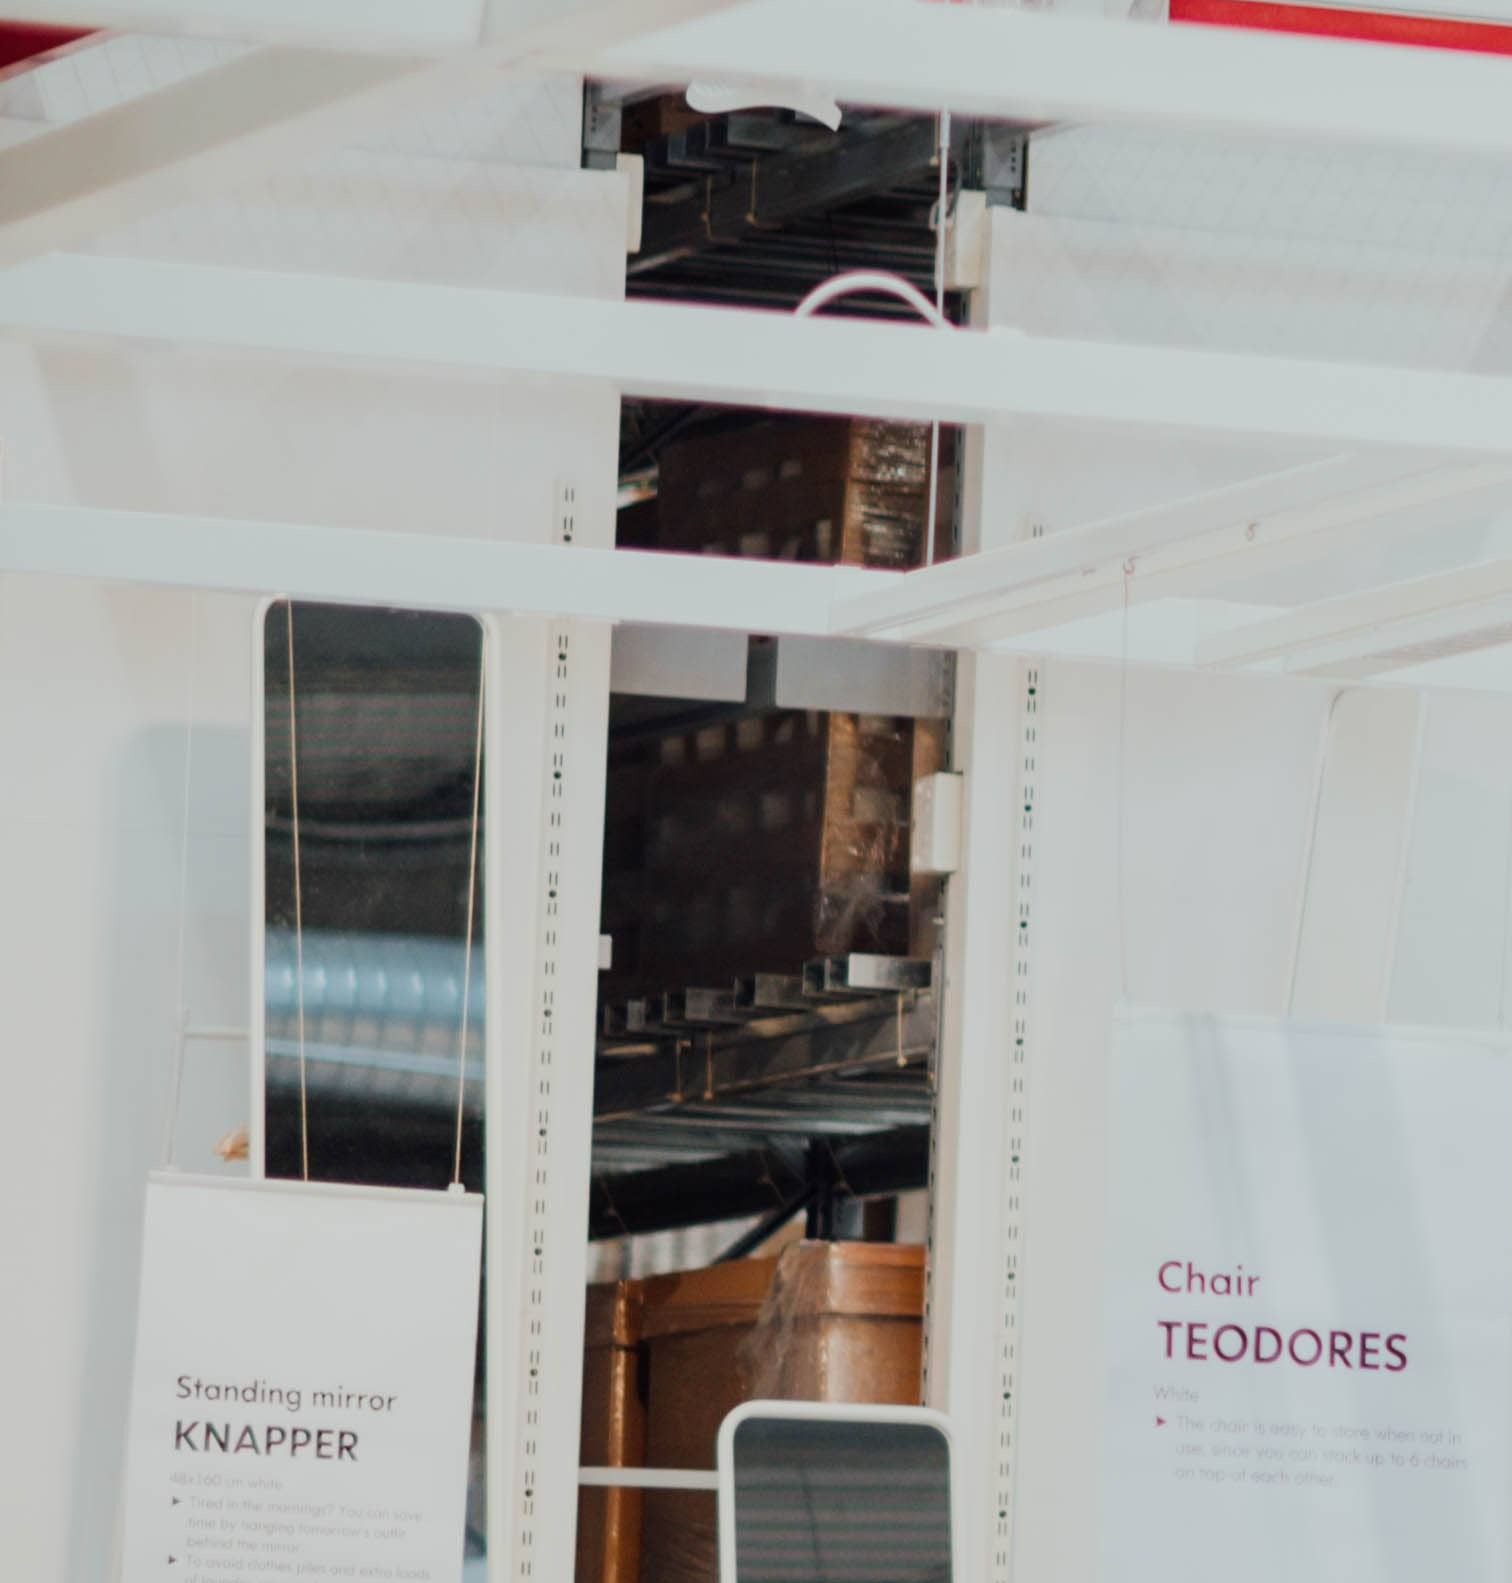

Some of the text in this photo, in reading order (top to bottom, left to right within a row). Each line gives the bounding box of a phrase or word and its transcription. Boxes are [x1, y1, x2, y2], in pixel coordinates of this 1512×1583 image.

[1158, 1260, 1262, 1298] Chair
[1157, 1320, 1409, 1373] TEODORES
[175, 1374, 399, 1413] Standing mirror
[174, 1420, 360, 1463] KNAPPER
